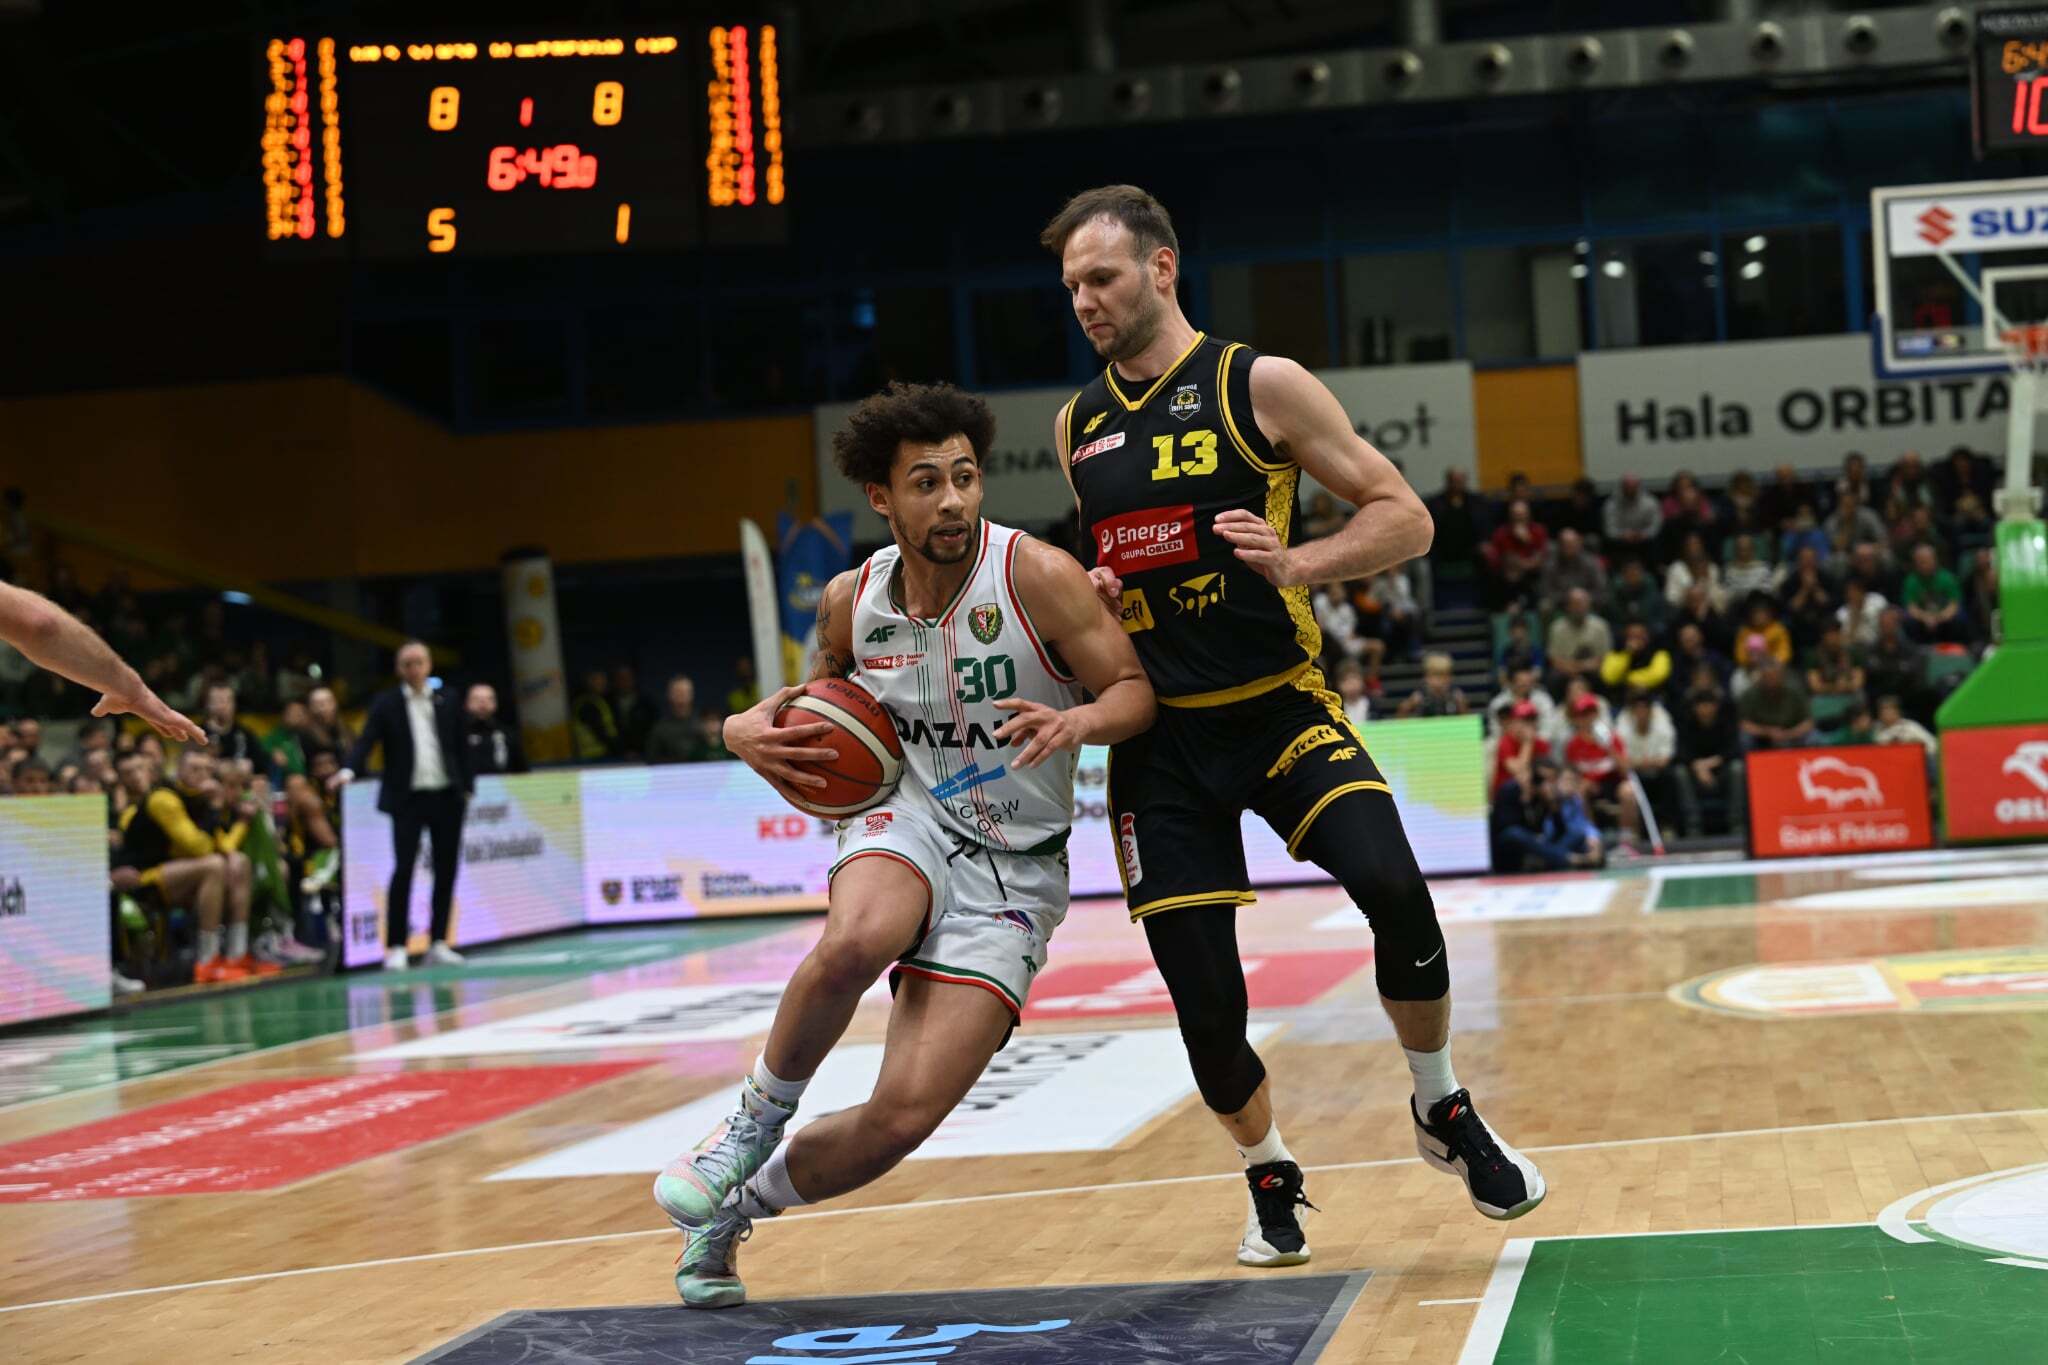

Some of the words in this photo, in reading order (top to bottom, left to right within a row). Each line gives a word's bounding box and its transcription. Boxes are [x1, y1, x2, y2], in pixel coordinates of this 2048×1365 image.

[519, 97, 533, 127] 1
[428, 208, 457, 253] 5
[616, 203, 631, 244] 1
[1616, 394, 1752, 445] Hala
[1780, 378, 2010, 434] ORBITA
[1151, 429, 1218, 480] 13
[1116, 521, 1182, 545] Energa
[1121, 548, 1146, 560] GRUPA
[1147, 542, 1183, 554] ORLEN
[1122, 600, 1144, 622] efl
[1169, 573, 1226, 618] Sopot
[954, 654, 1017, 703] 30
